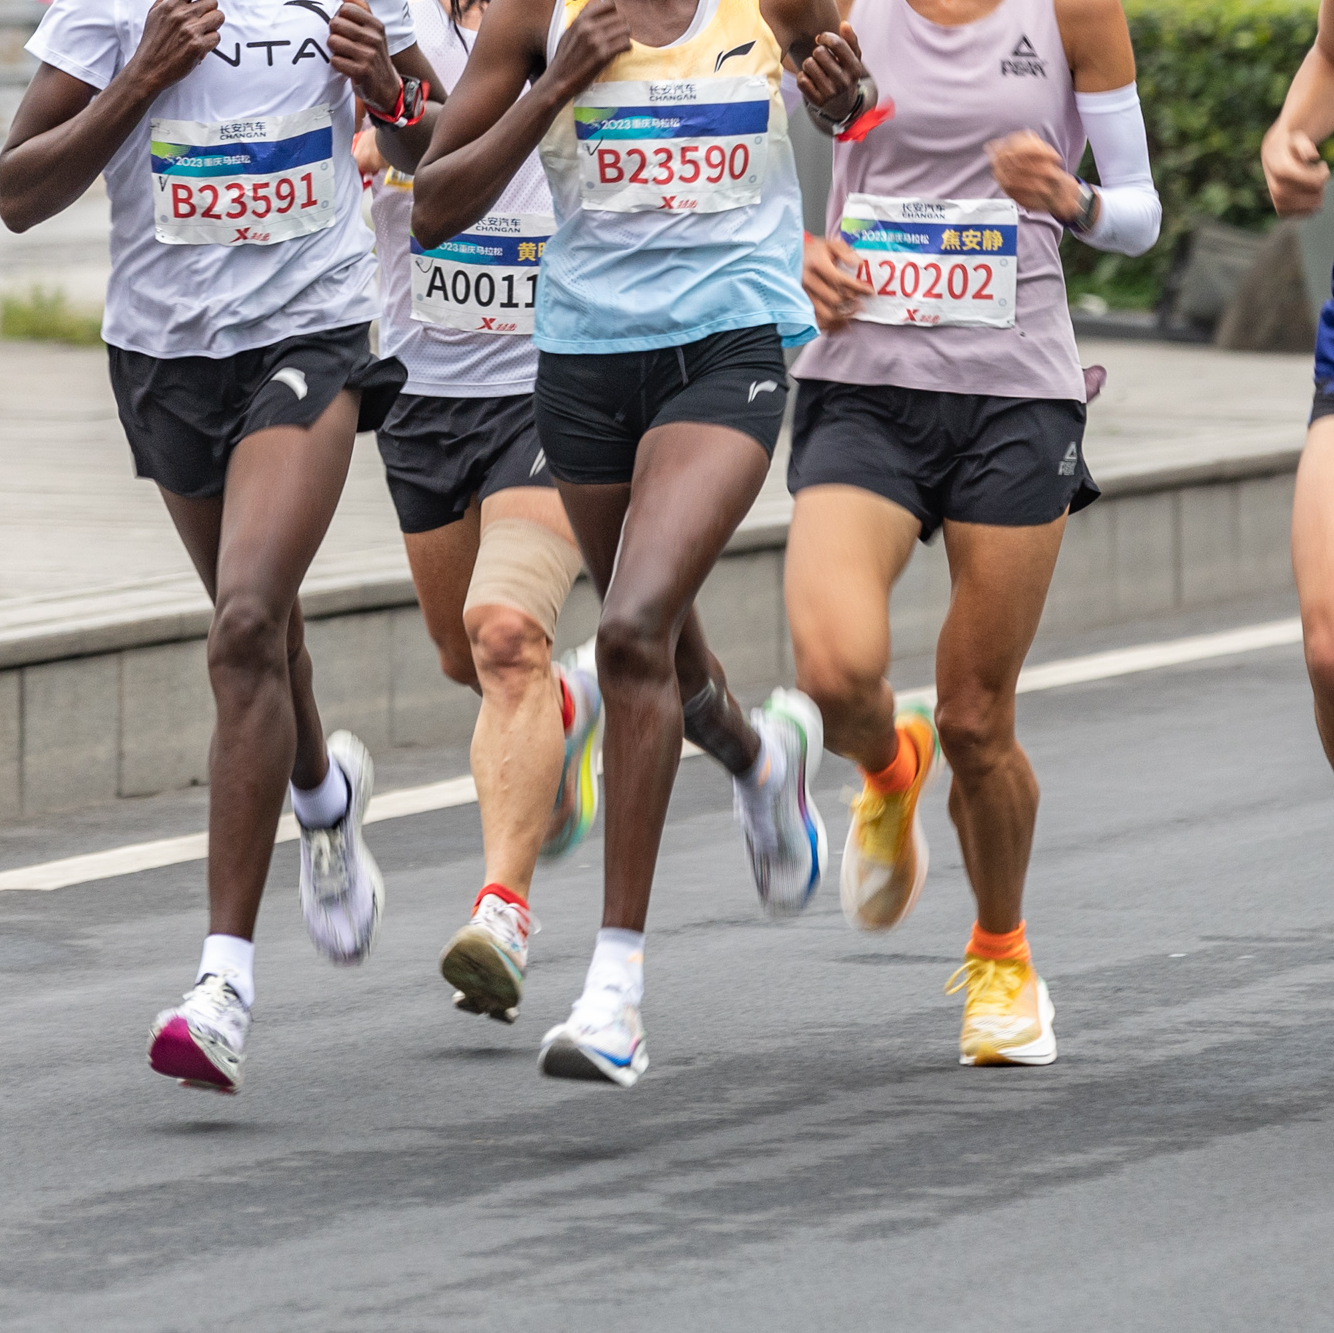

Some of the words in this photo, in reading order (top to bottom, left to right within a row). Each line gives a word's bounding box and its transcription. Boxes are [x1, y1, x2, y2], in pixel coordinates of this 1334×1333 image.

[212, 38, 331, 67] NTA
[649, 84, 696, 95] 长安汽车
[649, 94, 696, 102] CHANGAN
[219, 121, 267, 135] 长安汽车
[219, 131, 267, 141] CHANGAN
[175, 155, 251, 167] 2023重庆马拉松
[597, 143, 750, 185] B23590
[171, 172, 317, 220] B23591
[476, 225, 521, 233] CHANGAN
[940, 229, 1004, 251] 焦安静
[426, 266, 539, 308] A0011
[856, 259, 994, 300] A20202
